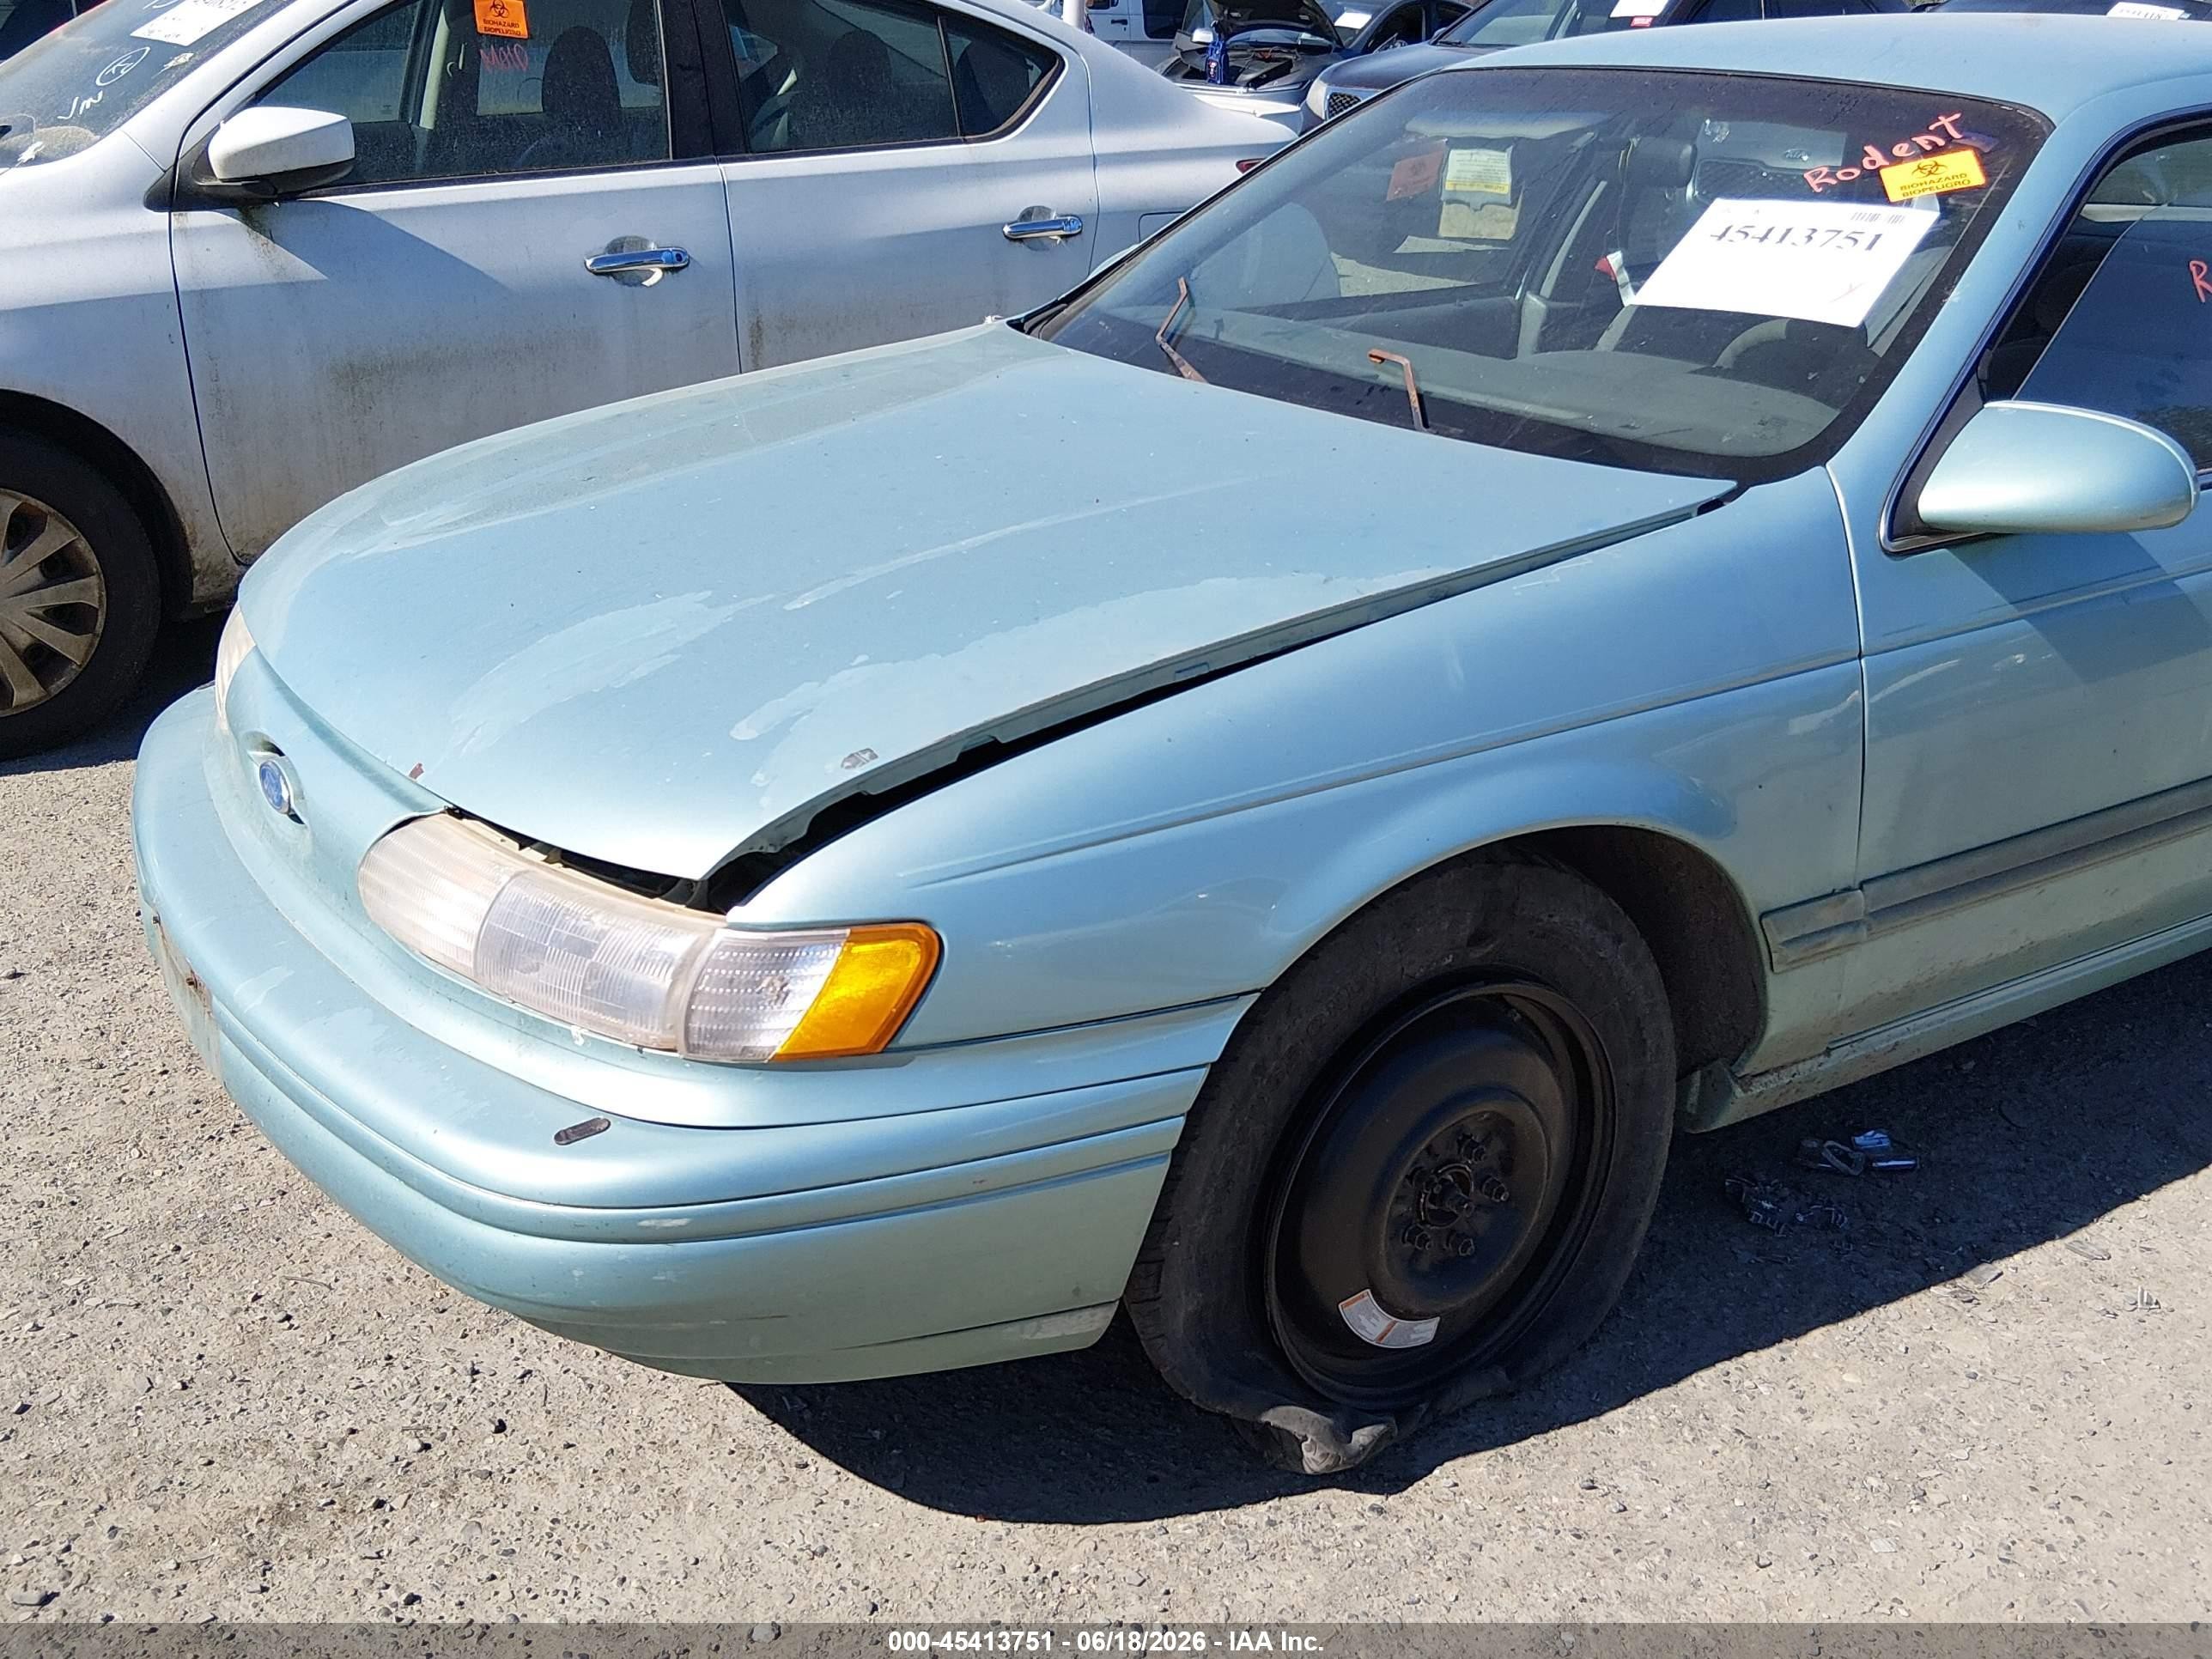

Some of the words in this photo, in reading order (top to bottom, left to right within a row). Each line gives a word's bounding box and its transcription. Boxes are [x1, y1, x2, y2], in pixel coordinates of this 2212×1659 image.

[482, 18, 520, 28] BIOHAZARD
[1802, 112, 1965, 193] Rodent
[1899, 173, 1968, 191] BIOHAZARD
[1901, 179, 1972, 198] BIOPELIGRO
[1709, 223, 1884, 252] 45413751
